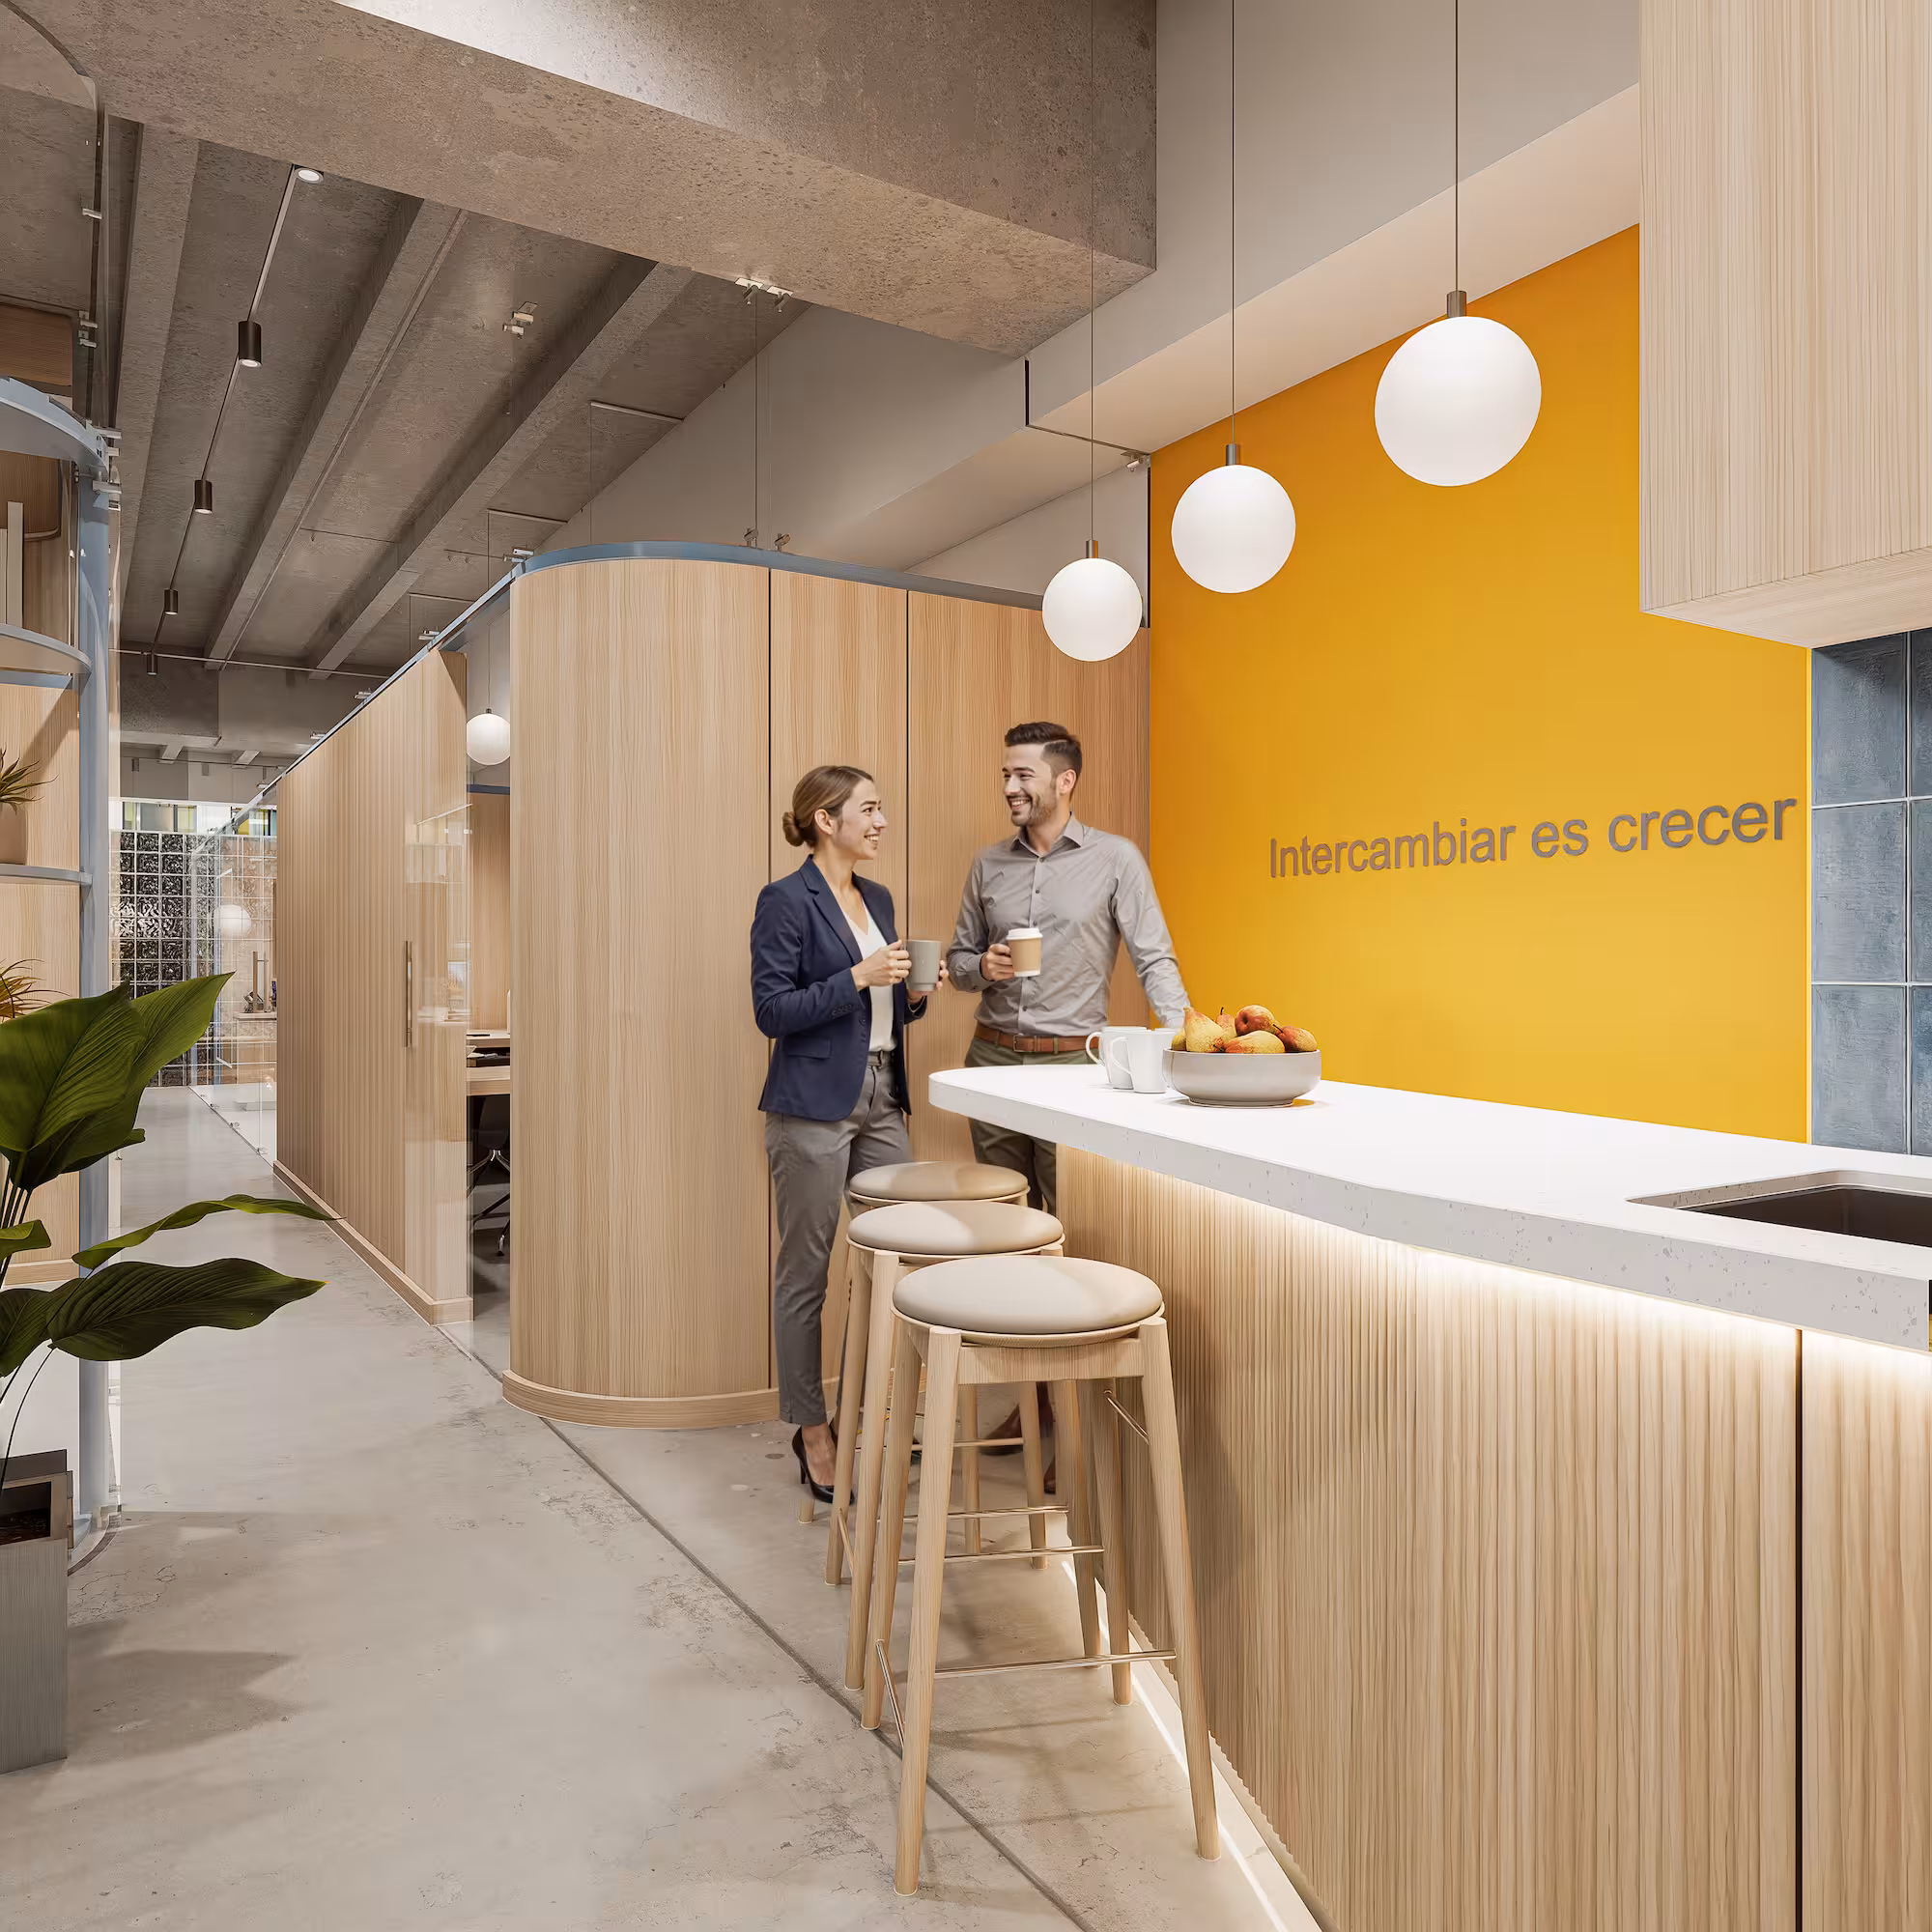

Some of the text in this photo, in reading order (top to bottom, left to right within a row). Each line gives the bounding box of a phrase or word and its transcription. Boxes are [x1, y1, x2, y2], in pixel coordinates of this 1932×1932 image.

[1269, 798, 1797, 878] Intercambiar es crecer
